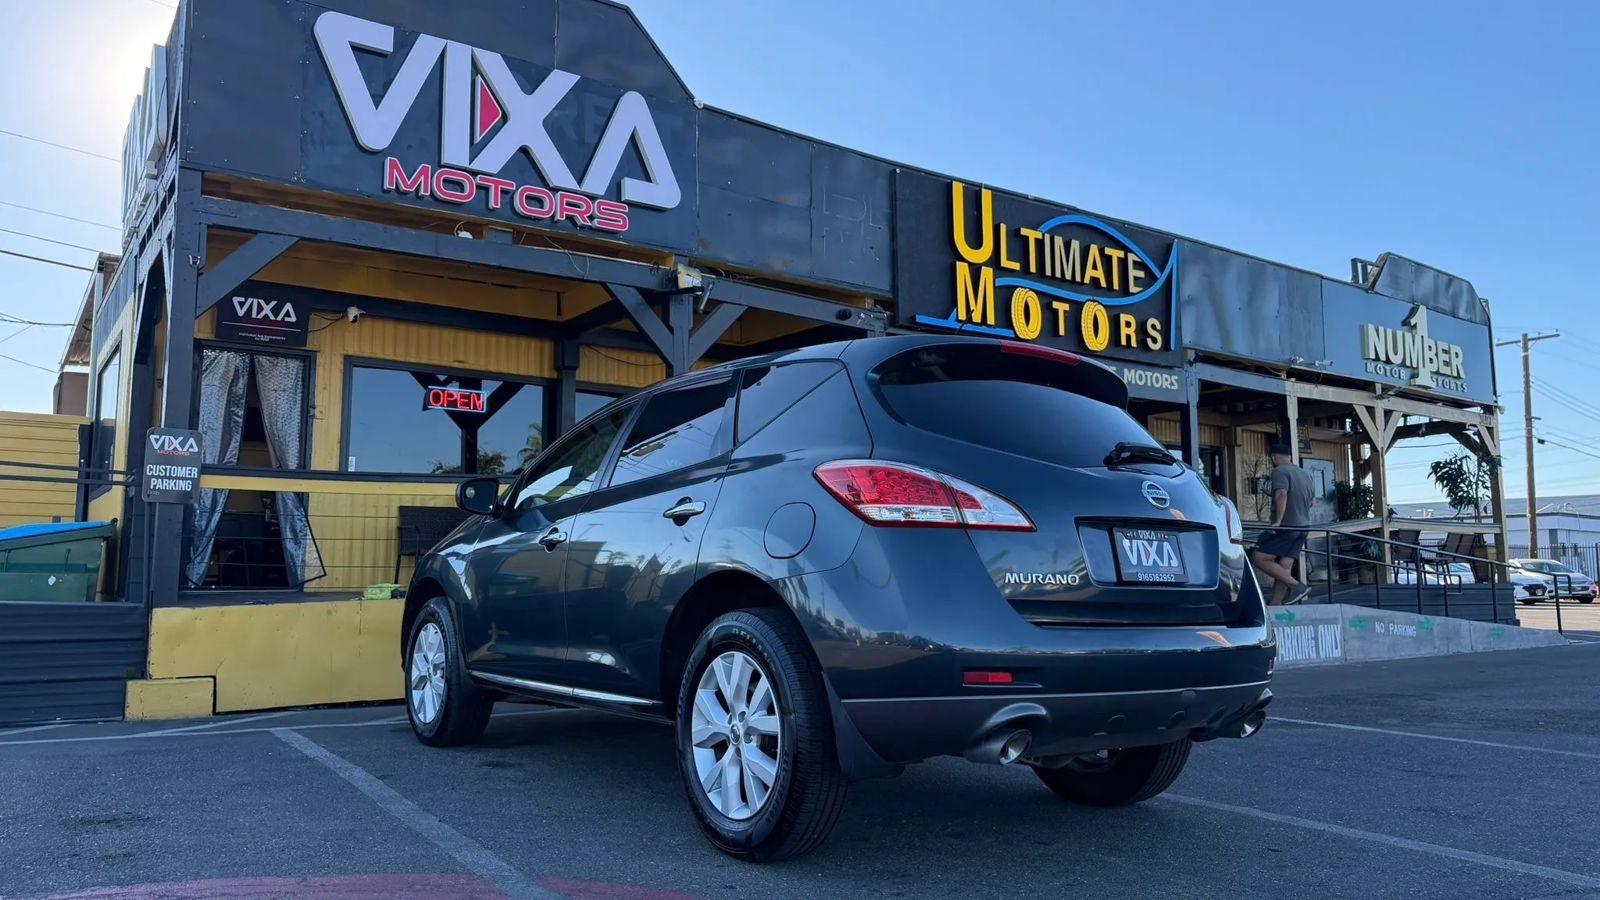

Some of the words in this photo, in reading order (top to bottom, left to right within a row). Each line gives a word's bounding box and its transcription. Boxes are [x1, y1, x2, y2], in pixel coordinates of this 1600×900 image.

[314, 11, 681, 209] VIXA
[384, 157, 629, 232] MOTORS
[952, 180, 1147, 294] ULTIMATE
[232, 296, 297, 322] VIXA
[956, 261, 1163, 351] MOTORS
[1362, 323, 1466, 379] NUMBER
[1123, 368, 1179, 390] MOTORS
[1366, 361, 1406, 380] MOTOR
[1431, 375, 1468, 393] SPORTS
[429, 389, 484, 411] OPEN
[149, 434, 199, 453] VIXA
[146, 464, 198, 478] CUSTOMER
[150, 478, 192, 491] PARKING
[1138, 530, 1156, 540] VIXA
[1122, 539, 1179, 567] VIXA
[1004, 572, 1080, 586] MURANO
[1137, 573, 1176, 582] 9165162952
[1375, 621, 1385, 633] NO
[1389, 623, 1417, 637] PARKING
[1318, 624, 1342, 659] ONLY
